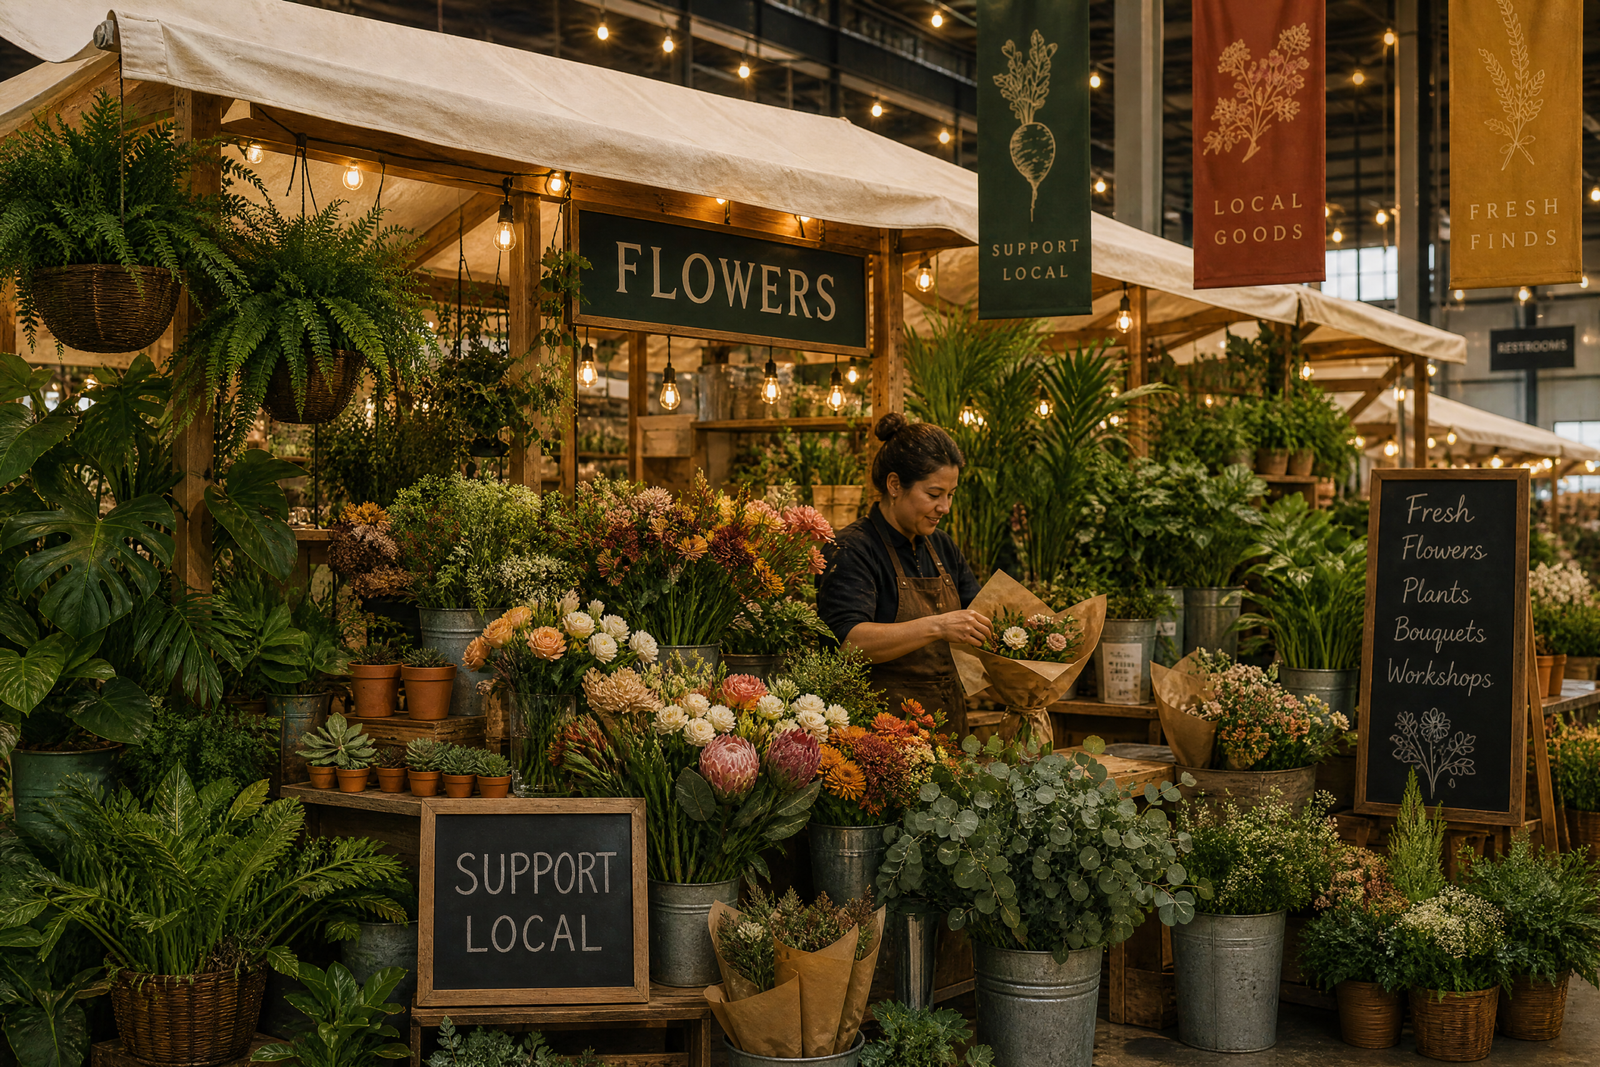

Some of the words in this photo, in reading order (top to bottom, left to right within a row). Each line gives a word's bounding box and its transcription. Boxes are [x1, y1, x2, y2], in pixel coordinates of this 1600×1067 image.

[1214, 193, 1302, 215] LOCAL
[1470, 198, 1558, 220] FRESH
[992, 239, 1079, 257] SUPPORT
[1214, 224, 1302, 245] GOODS
[1471, 229, 1557, 250] FINDS
[615, 241, 836, 323] FLOWERS
[1003, 265, 1068, 281] LOCAL
[1497, 339, 1568, 354] RESTROOMS
[1405, 493, 1475, 524] Fresh
[1402, 534, 1488, 561] Flowers
[1402, 577, 1472, 604] Plants
[1394, 615, 1487, 653] Bouquets
[1387, 658, 1492, 696] Workshops
[455, 851, 618, 896] SUPPORT
[466, 914, 603, 953] LOCAL
